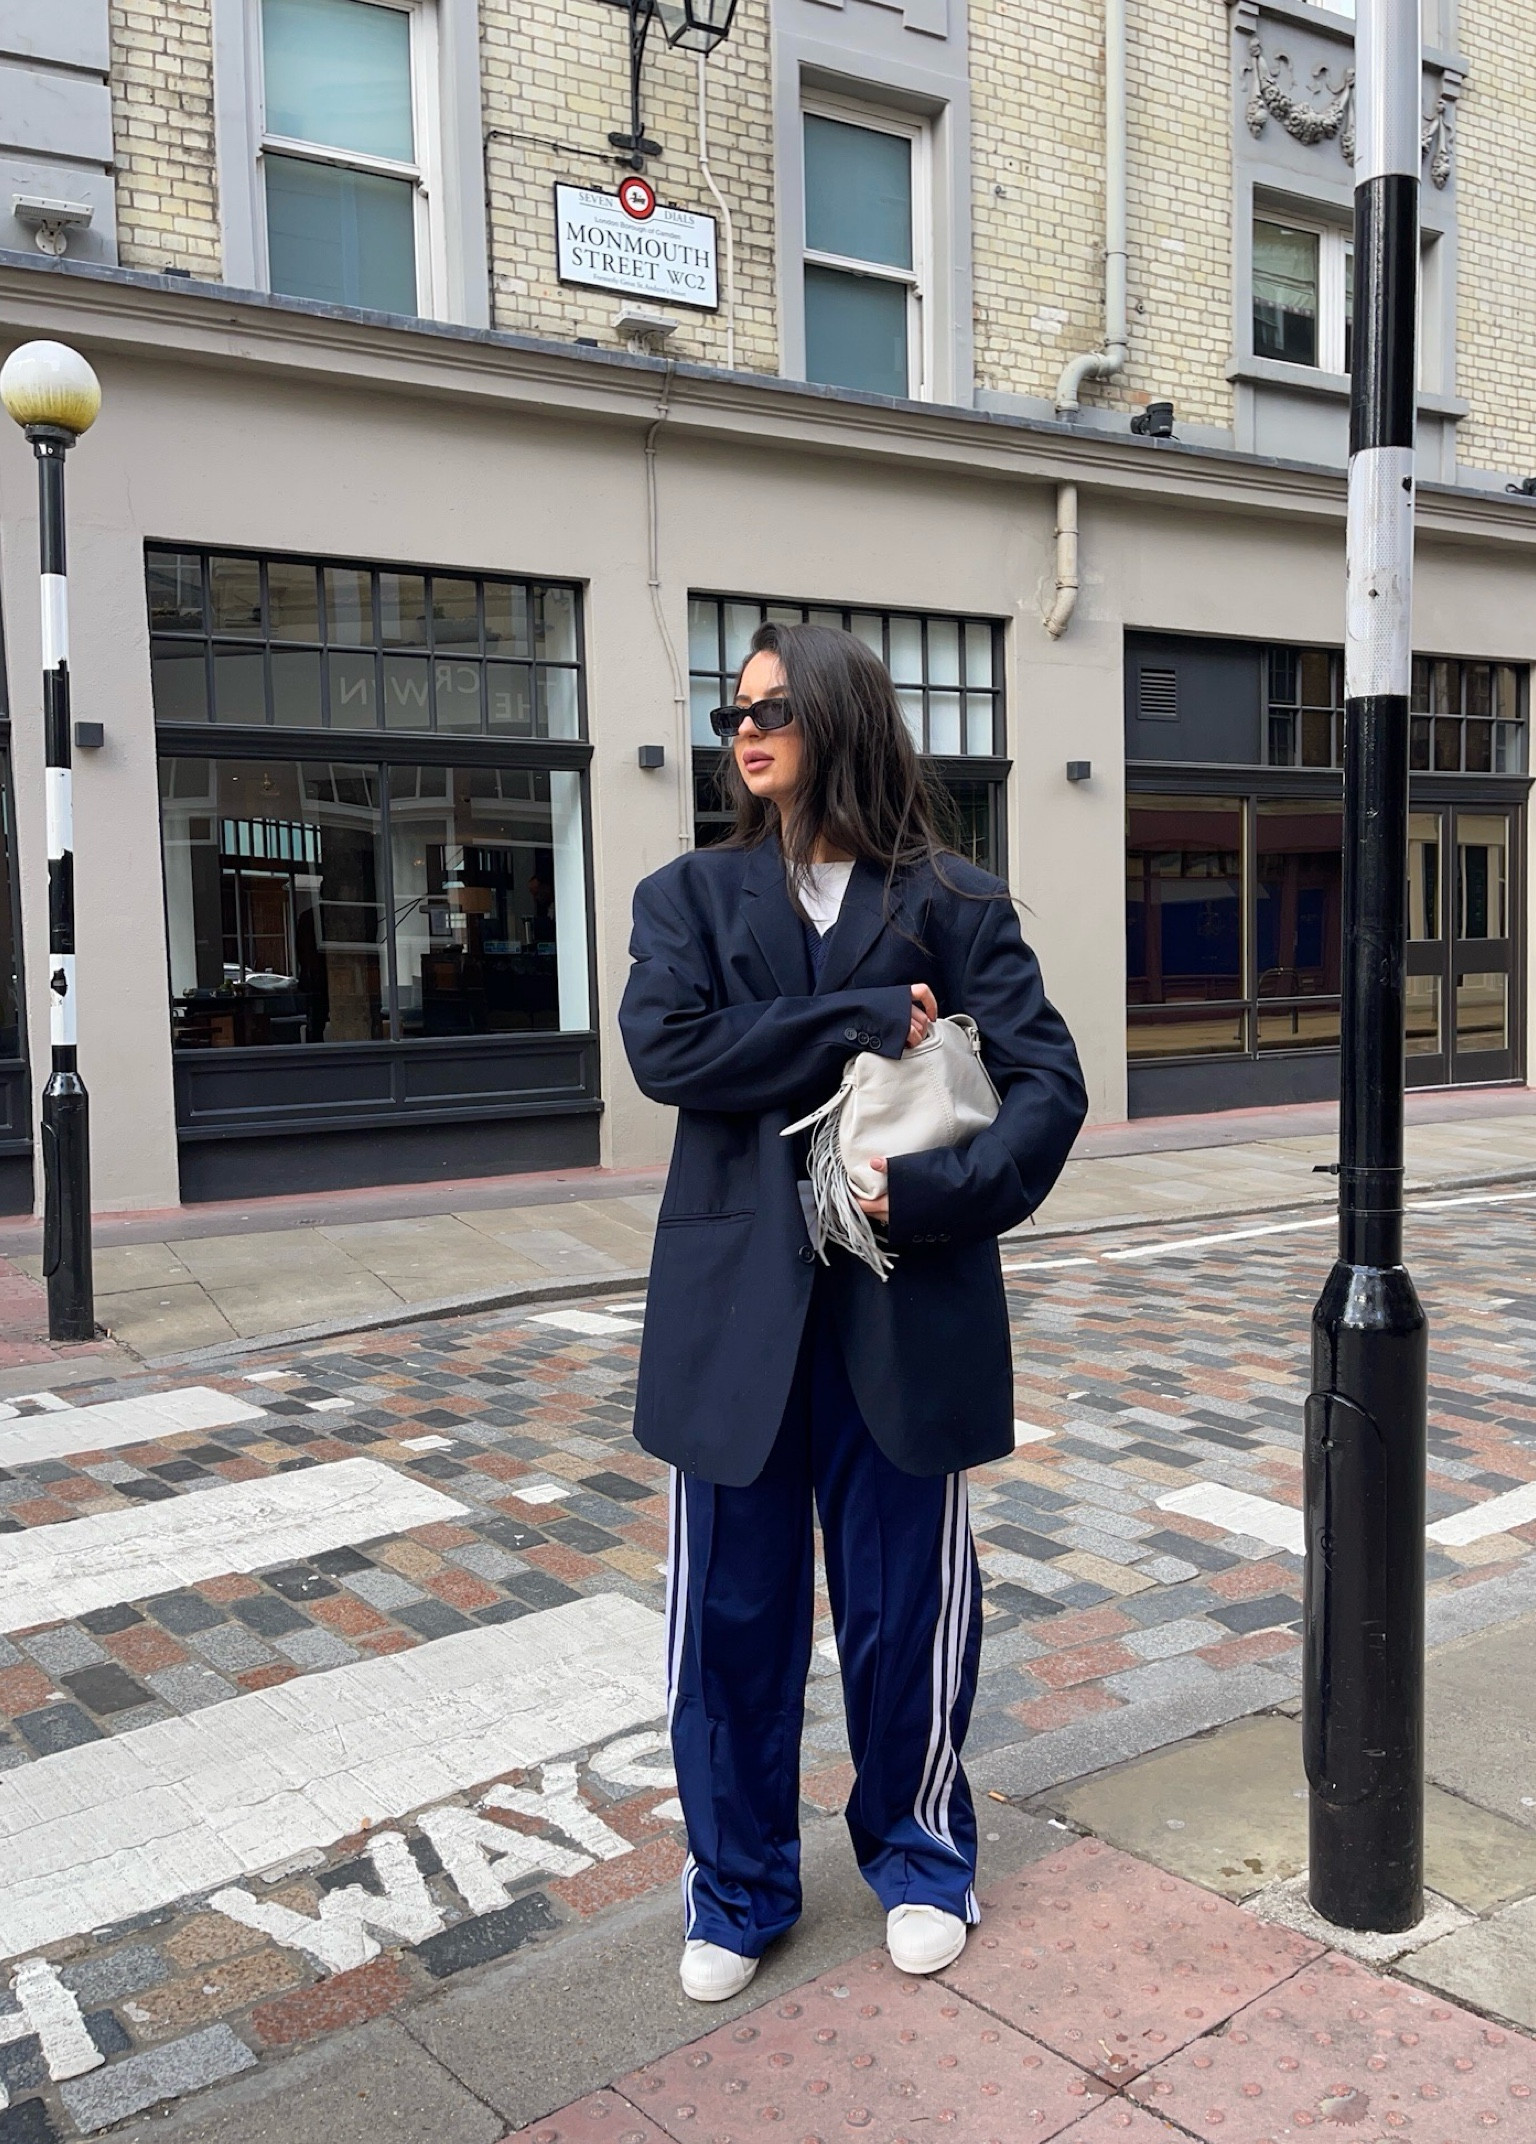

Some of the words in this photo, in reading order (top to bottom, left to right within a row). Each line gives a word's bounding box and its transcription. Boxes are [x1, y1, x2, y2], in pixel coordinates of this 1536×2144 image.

[579, 192, 614, 208] SEVEN
[664, 210, 695, 225] DIALS
[594, 216, 619, 227] London
[566, 221, 711, 269] MONMOUTH
[571, 246, 660, 281] STREET
[666, 269, 707, 291] WC2
